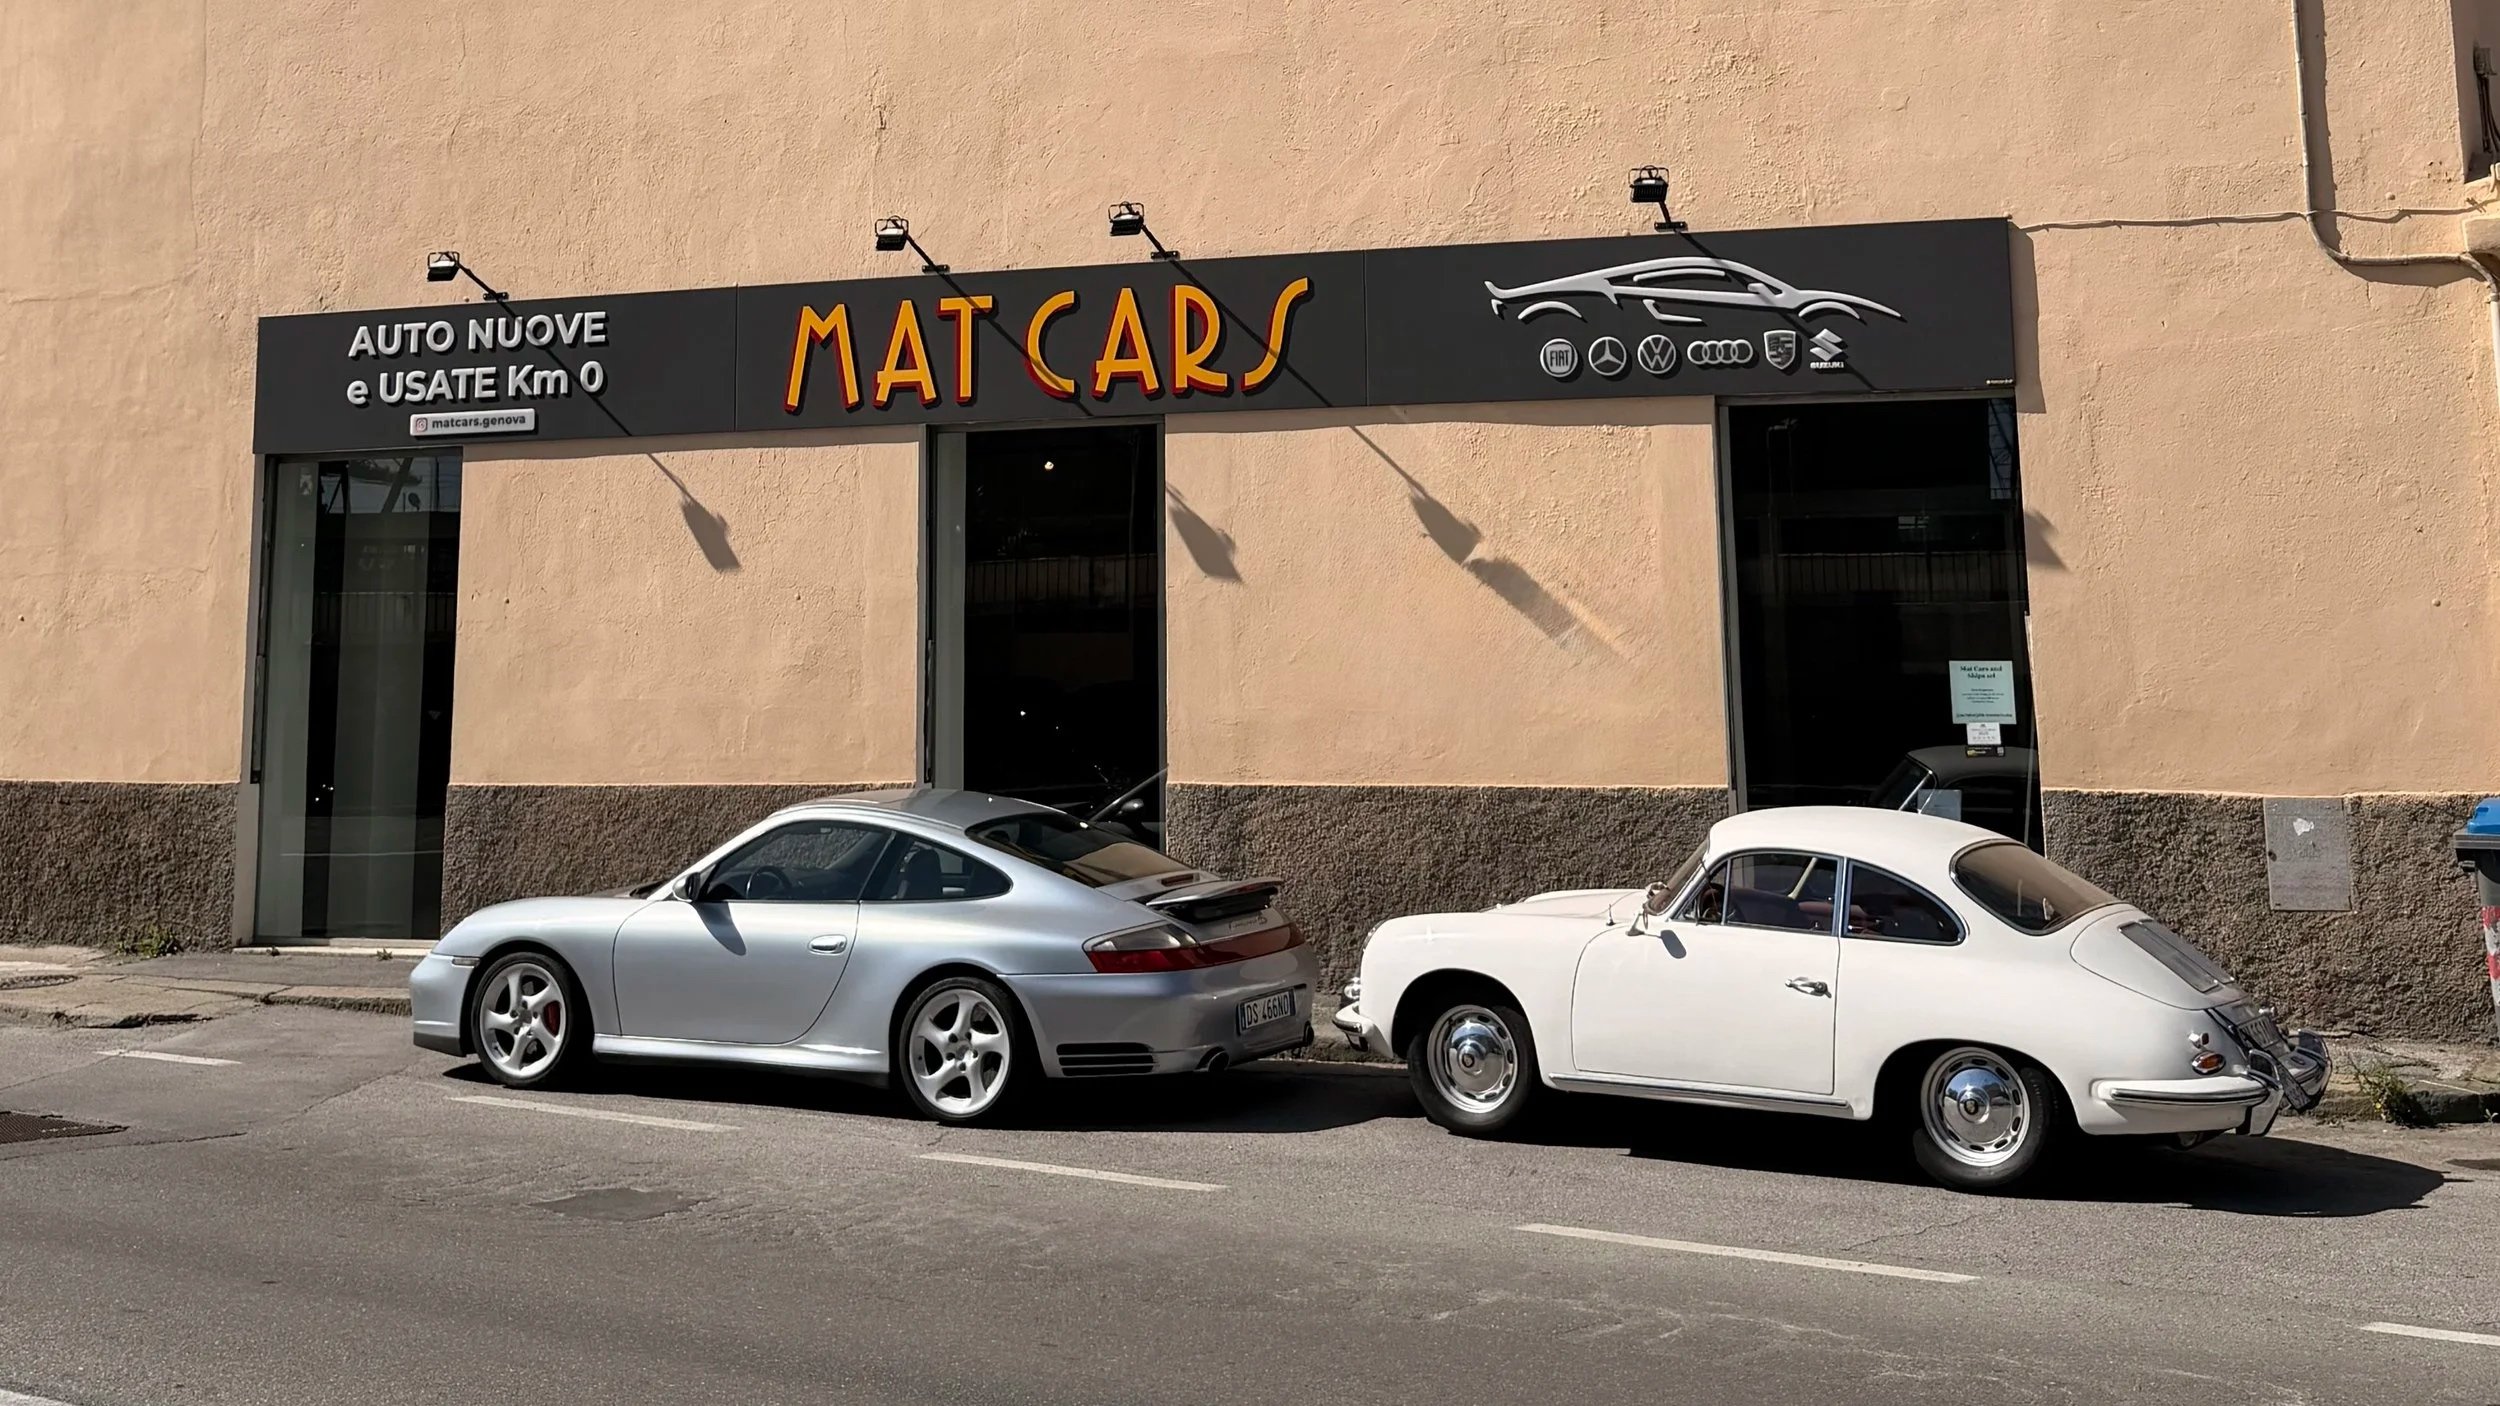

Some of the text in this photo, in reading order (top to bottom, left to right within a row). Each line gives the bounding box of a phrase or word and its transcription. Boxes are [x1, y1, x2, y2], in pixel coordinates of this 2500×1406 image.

[349, 311, 607, 357] AUTO NUOVE
[784, 277, 1309, 413] MAT CARS
[1550, 349, 1570, 368] FIAT
[1810, 361, 1845, 369] SUZUKI
[347, 360, 604, 404] e USATE Km 0
[432, 415, 526, 429] matcars.genova
[1246, 1003, 1259, 1026] DS
